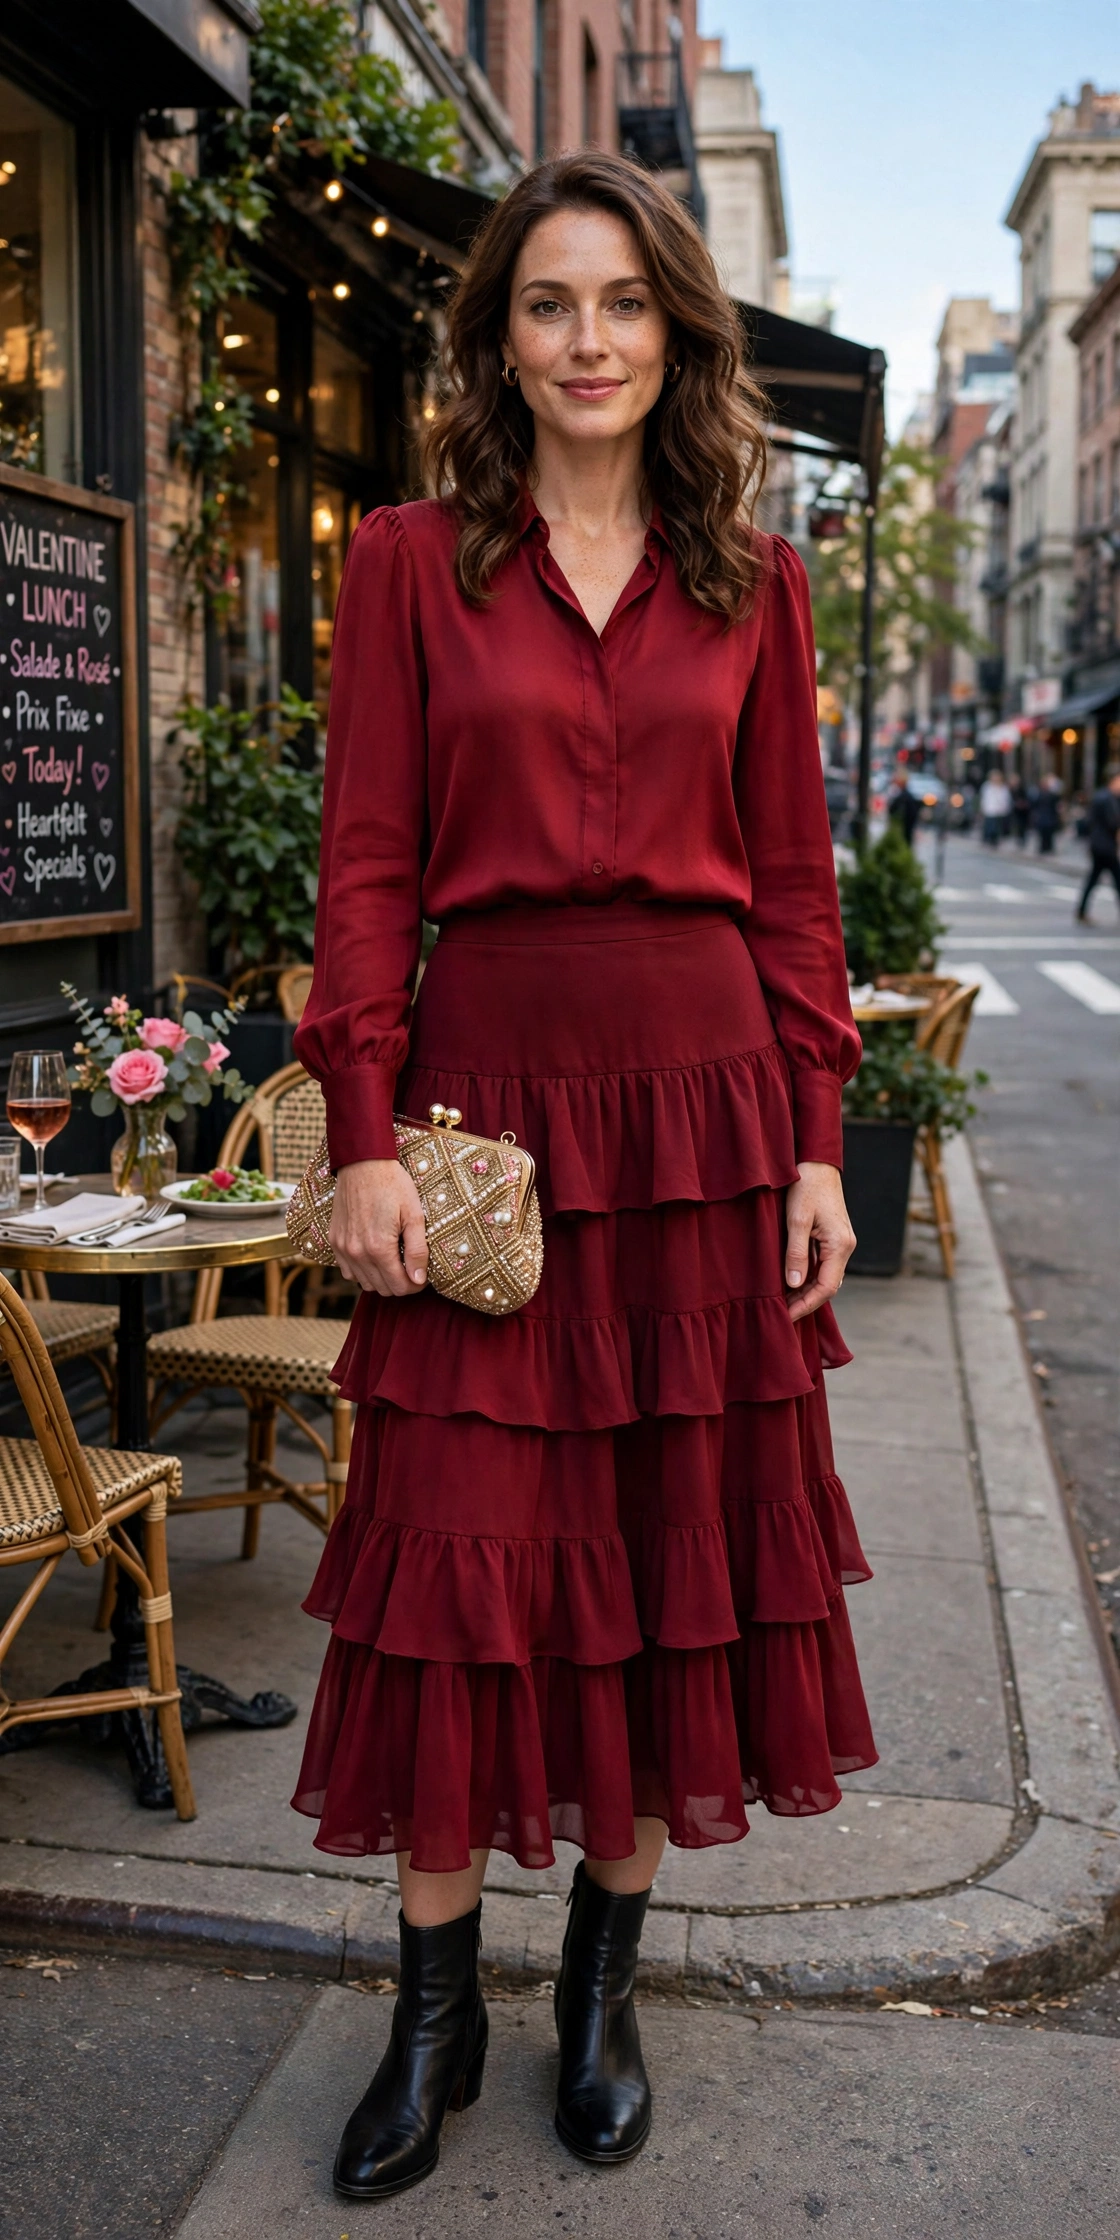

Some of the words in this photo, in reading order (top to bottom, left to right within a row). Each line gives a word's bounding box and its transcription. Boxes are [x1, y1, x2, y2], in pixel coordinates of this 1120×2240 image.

[0, 521, 107, 583] VALENTINE
[22, 580, 87, 630] LUNCH
[10, 638, 61, 678] Salade
[64, 652, 75, 679] &
[77, 647, 111, 685] Rosé
[16, 690, 50, 731] Prix
[56, 695, 91, 732] Fixe
[22, 744, 83, 796] Today!
[17, 802, 88, 843] Heartfelt
[23, 843, 87, 893] Specials
